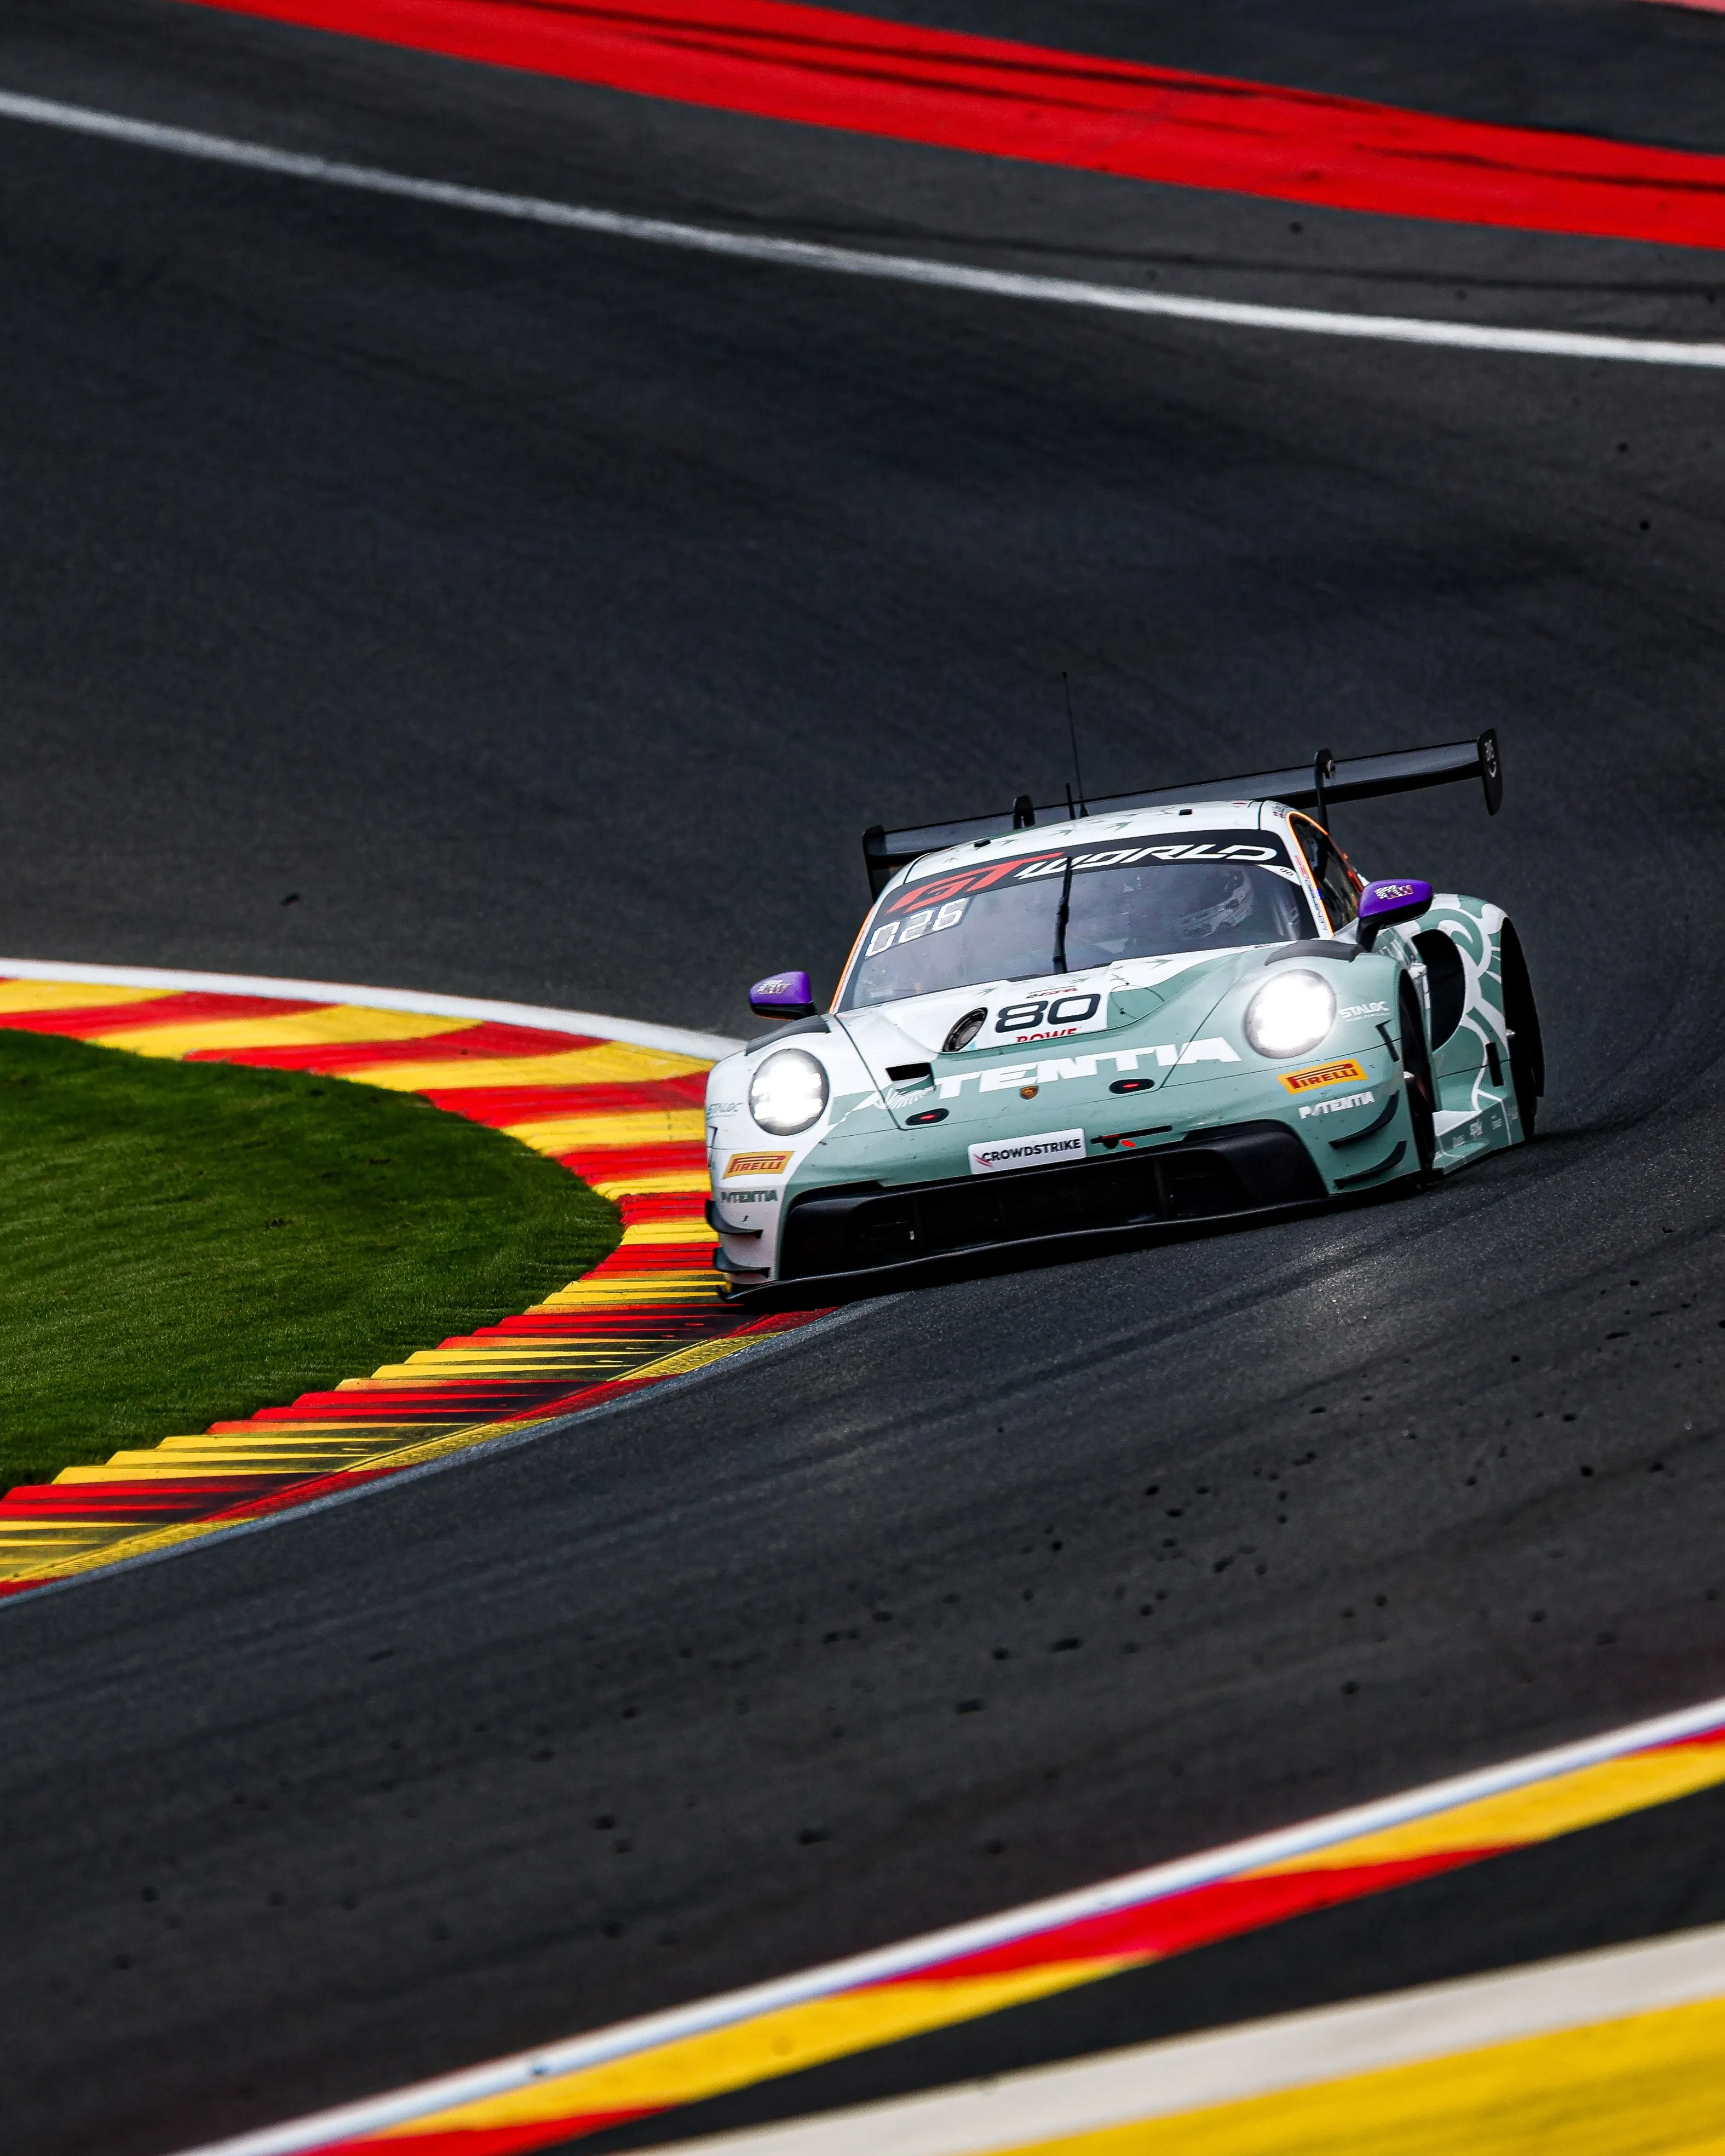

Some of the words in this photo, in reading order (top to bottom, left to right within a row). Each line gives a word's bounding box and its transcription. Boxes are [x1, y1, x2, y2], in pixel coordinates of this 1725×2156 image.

[885, 852, 1065, 915] GT
[1014, 844, 1277, 880] WORLD
[865, 898, 968, 957] 026
[995, 993, 1101, 1033] 80
[1338, 1000, 1389, 1020] STALOC
[1286, 1062, 1359, 1089] PIRELLI
[981, 1138, 1082, 1163] CROWDSTRIKE
[727, 1155, 786, 1174] PIRELLI
